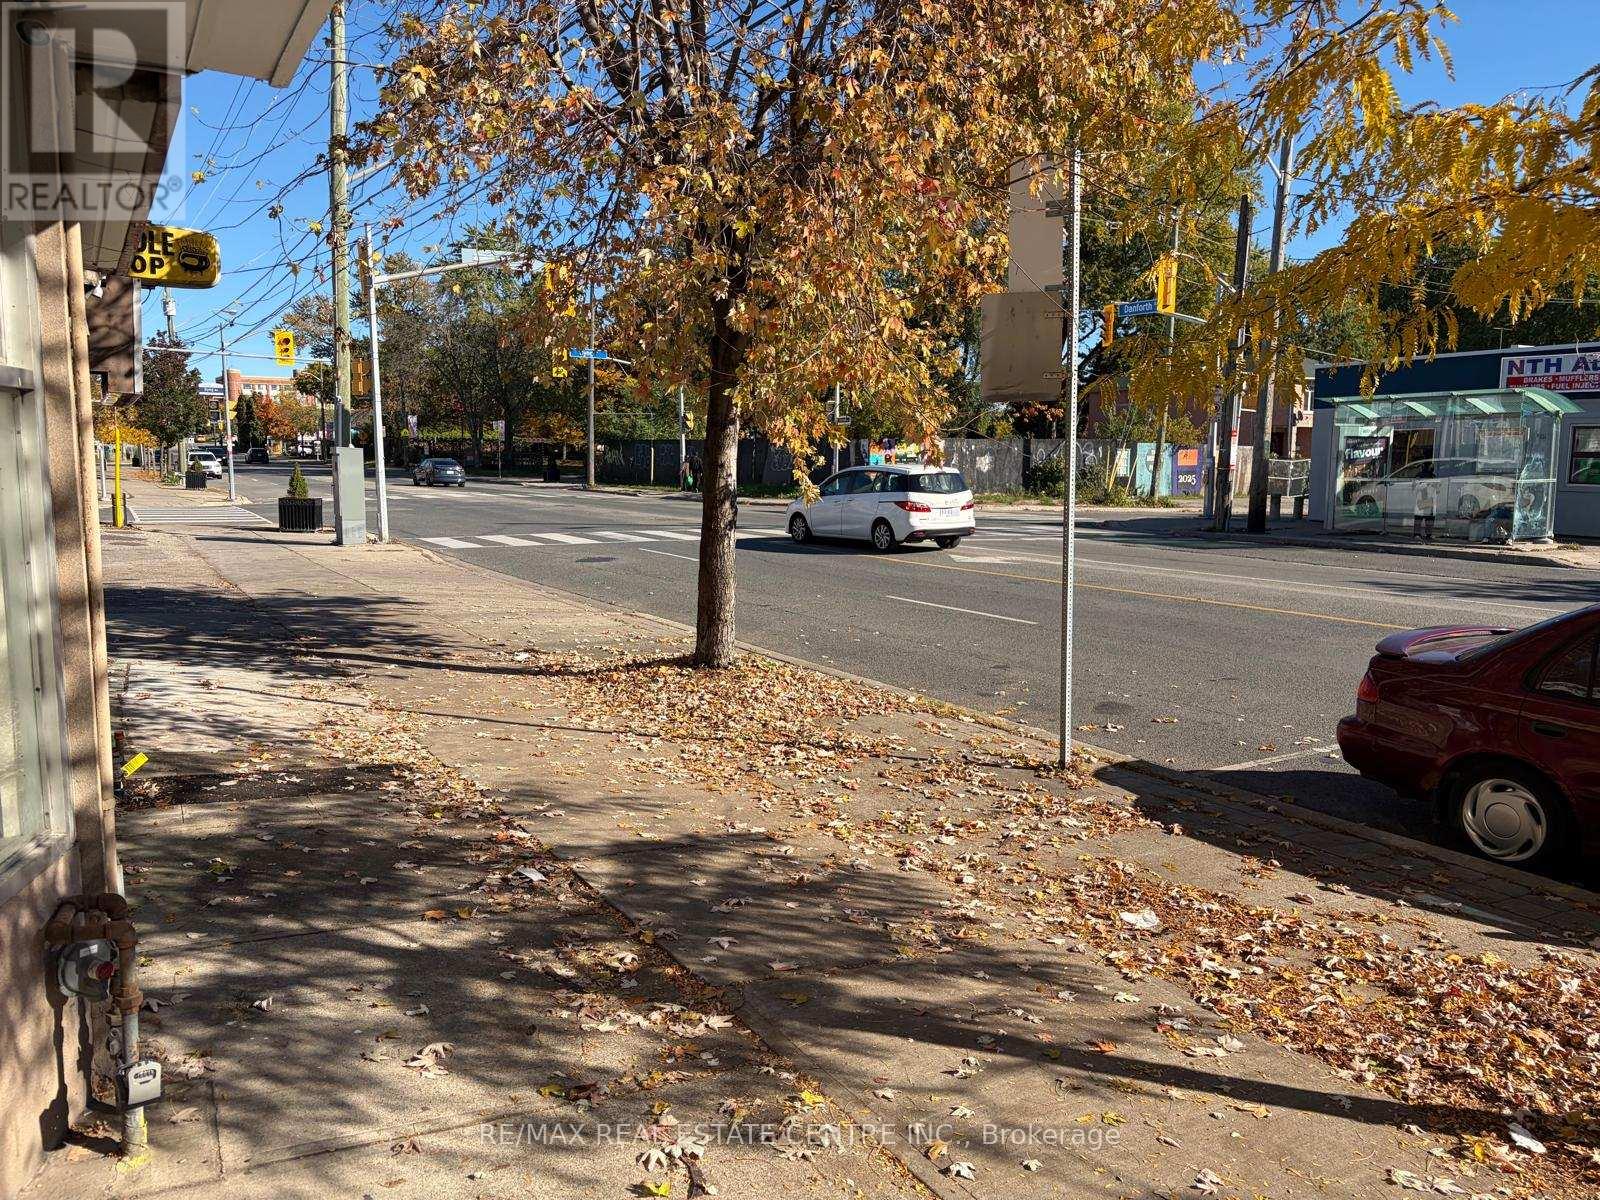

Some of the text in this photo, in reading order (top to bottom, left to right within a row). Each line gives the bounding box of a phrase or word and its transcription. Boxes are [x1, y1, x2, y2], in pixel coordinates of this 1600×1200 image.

[1124, 302, 1153, 313] Danforth
[1507, 357, 1562, 376] NTH
[1523, 376, 1553, 384] BRAKES
[1551, 382, 1571, 390] FUEL
[1178, 474, 1196, 485] 2025
